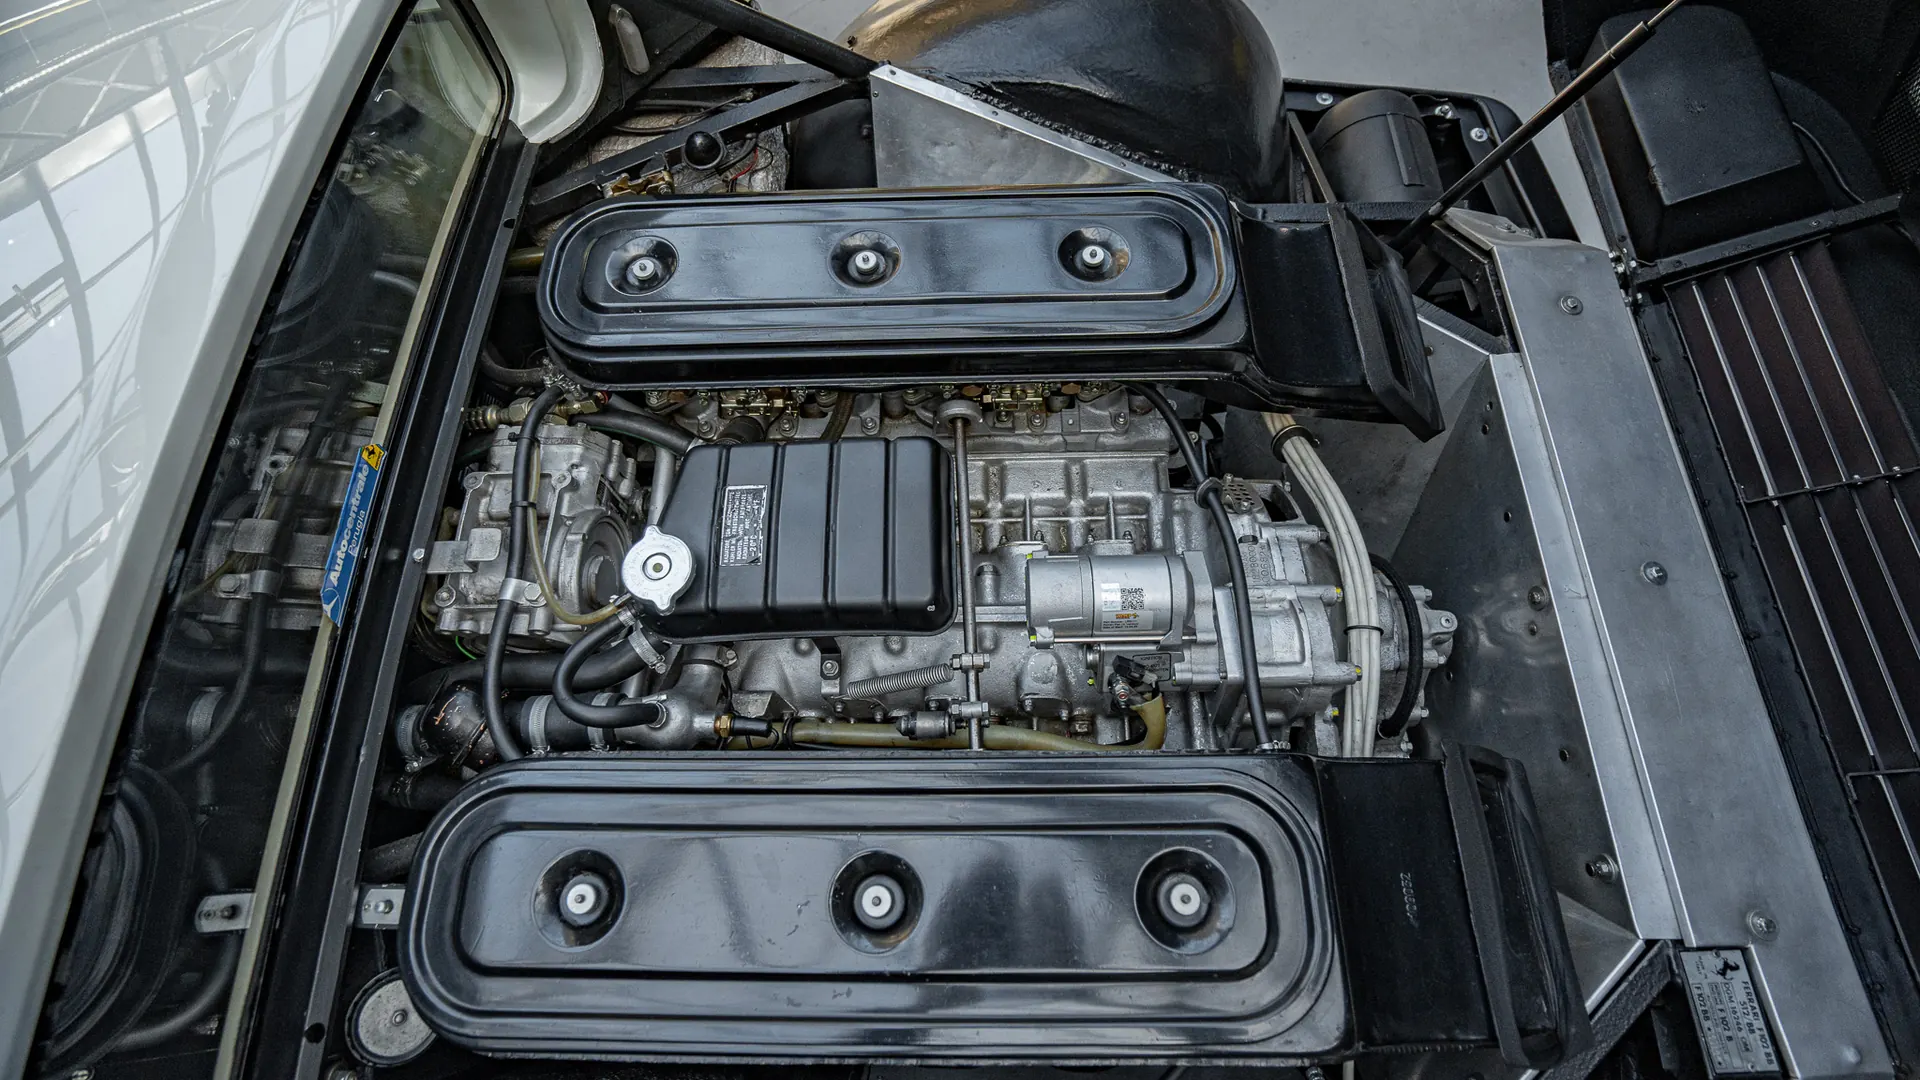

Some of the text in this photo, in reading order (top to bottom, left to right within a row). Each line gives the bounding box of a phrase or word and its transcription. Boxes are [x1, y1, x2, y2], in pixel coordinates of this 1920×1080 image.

[329, 463, 370, 587] Autocentrale
[347, 509, 366, 557] Perugia
[1723, 982, 1735, 1004] DGM
[1730, 1006, 1743, 1033] 16246
[1741, 980, 1760, 1022] FERRARI
